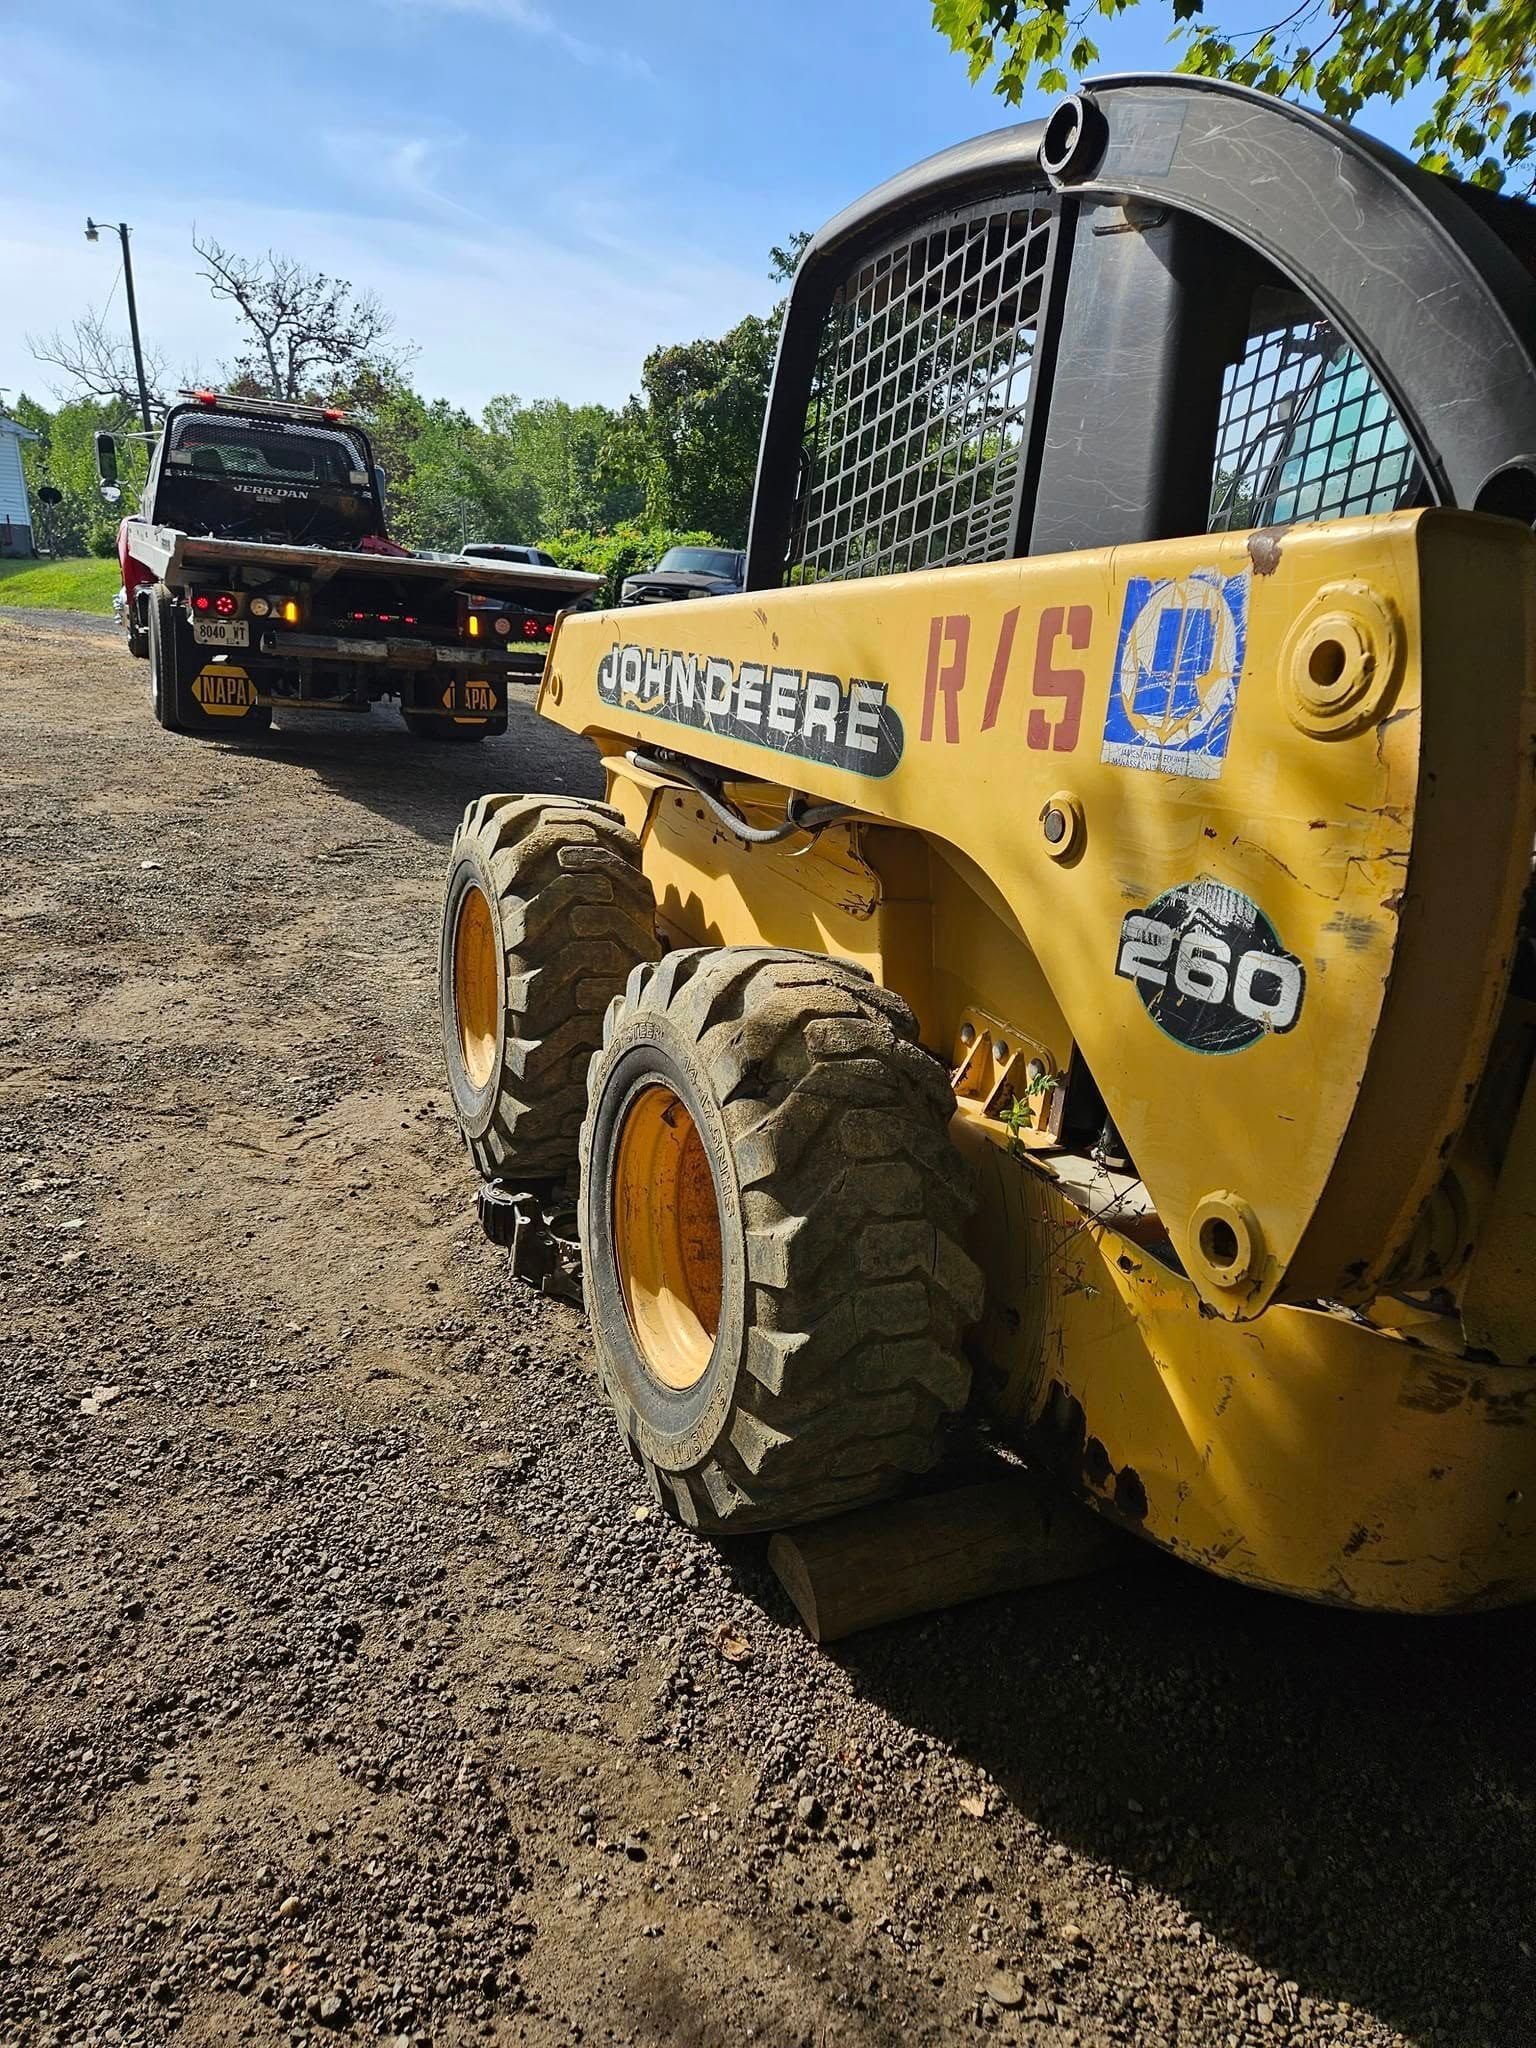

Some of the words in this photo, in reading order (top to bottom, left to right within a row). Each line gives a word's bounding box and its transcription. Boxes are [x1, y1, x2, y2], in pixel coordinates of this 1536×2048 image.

[200, 625, 226, 639] 8040
[203, 676, 247, 705] NAPA
[602, 644, 698, 709] JOHN
[703, 655, 885, 754] DEERE
[1118, 914, 1302, 1028] 260
